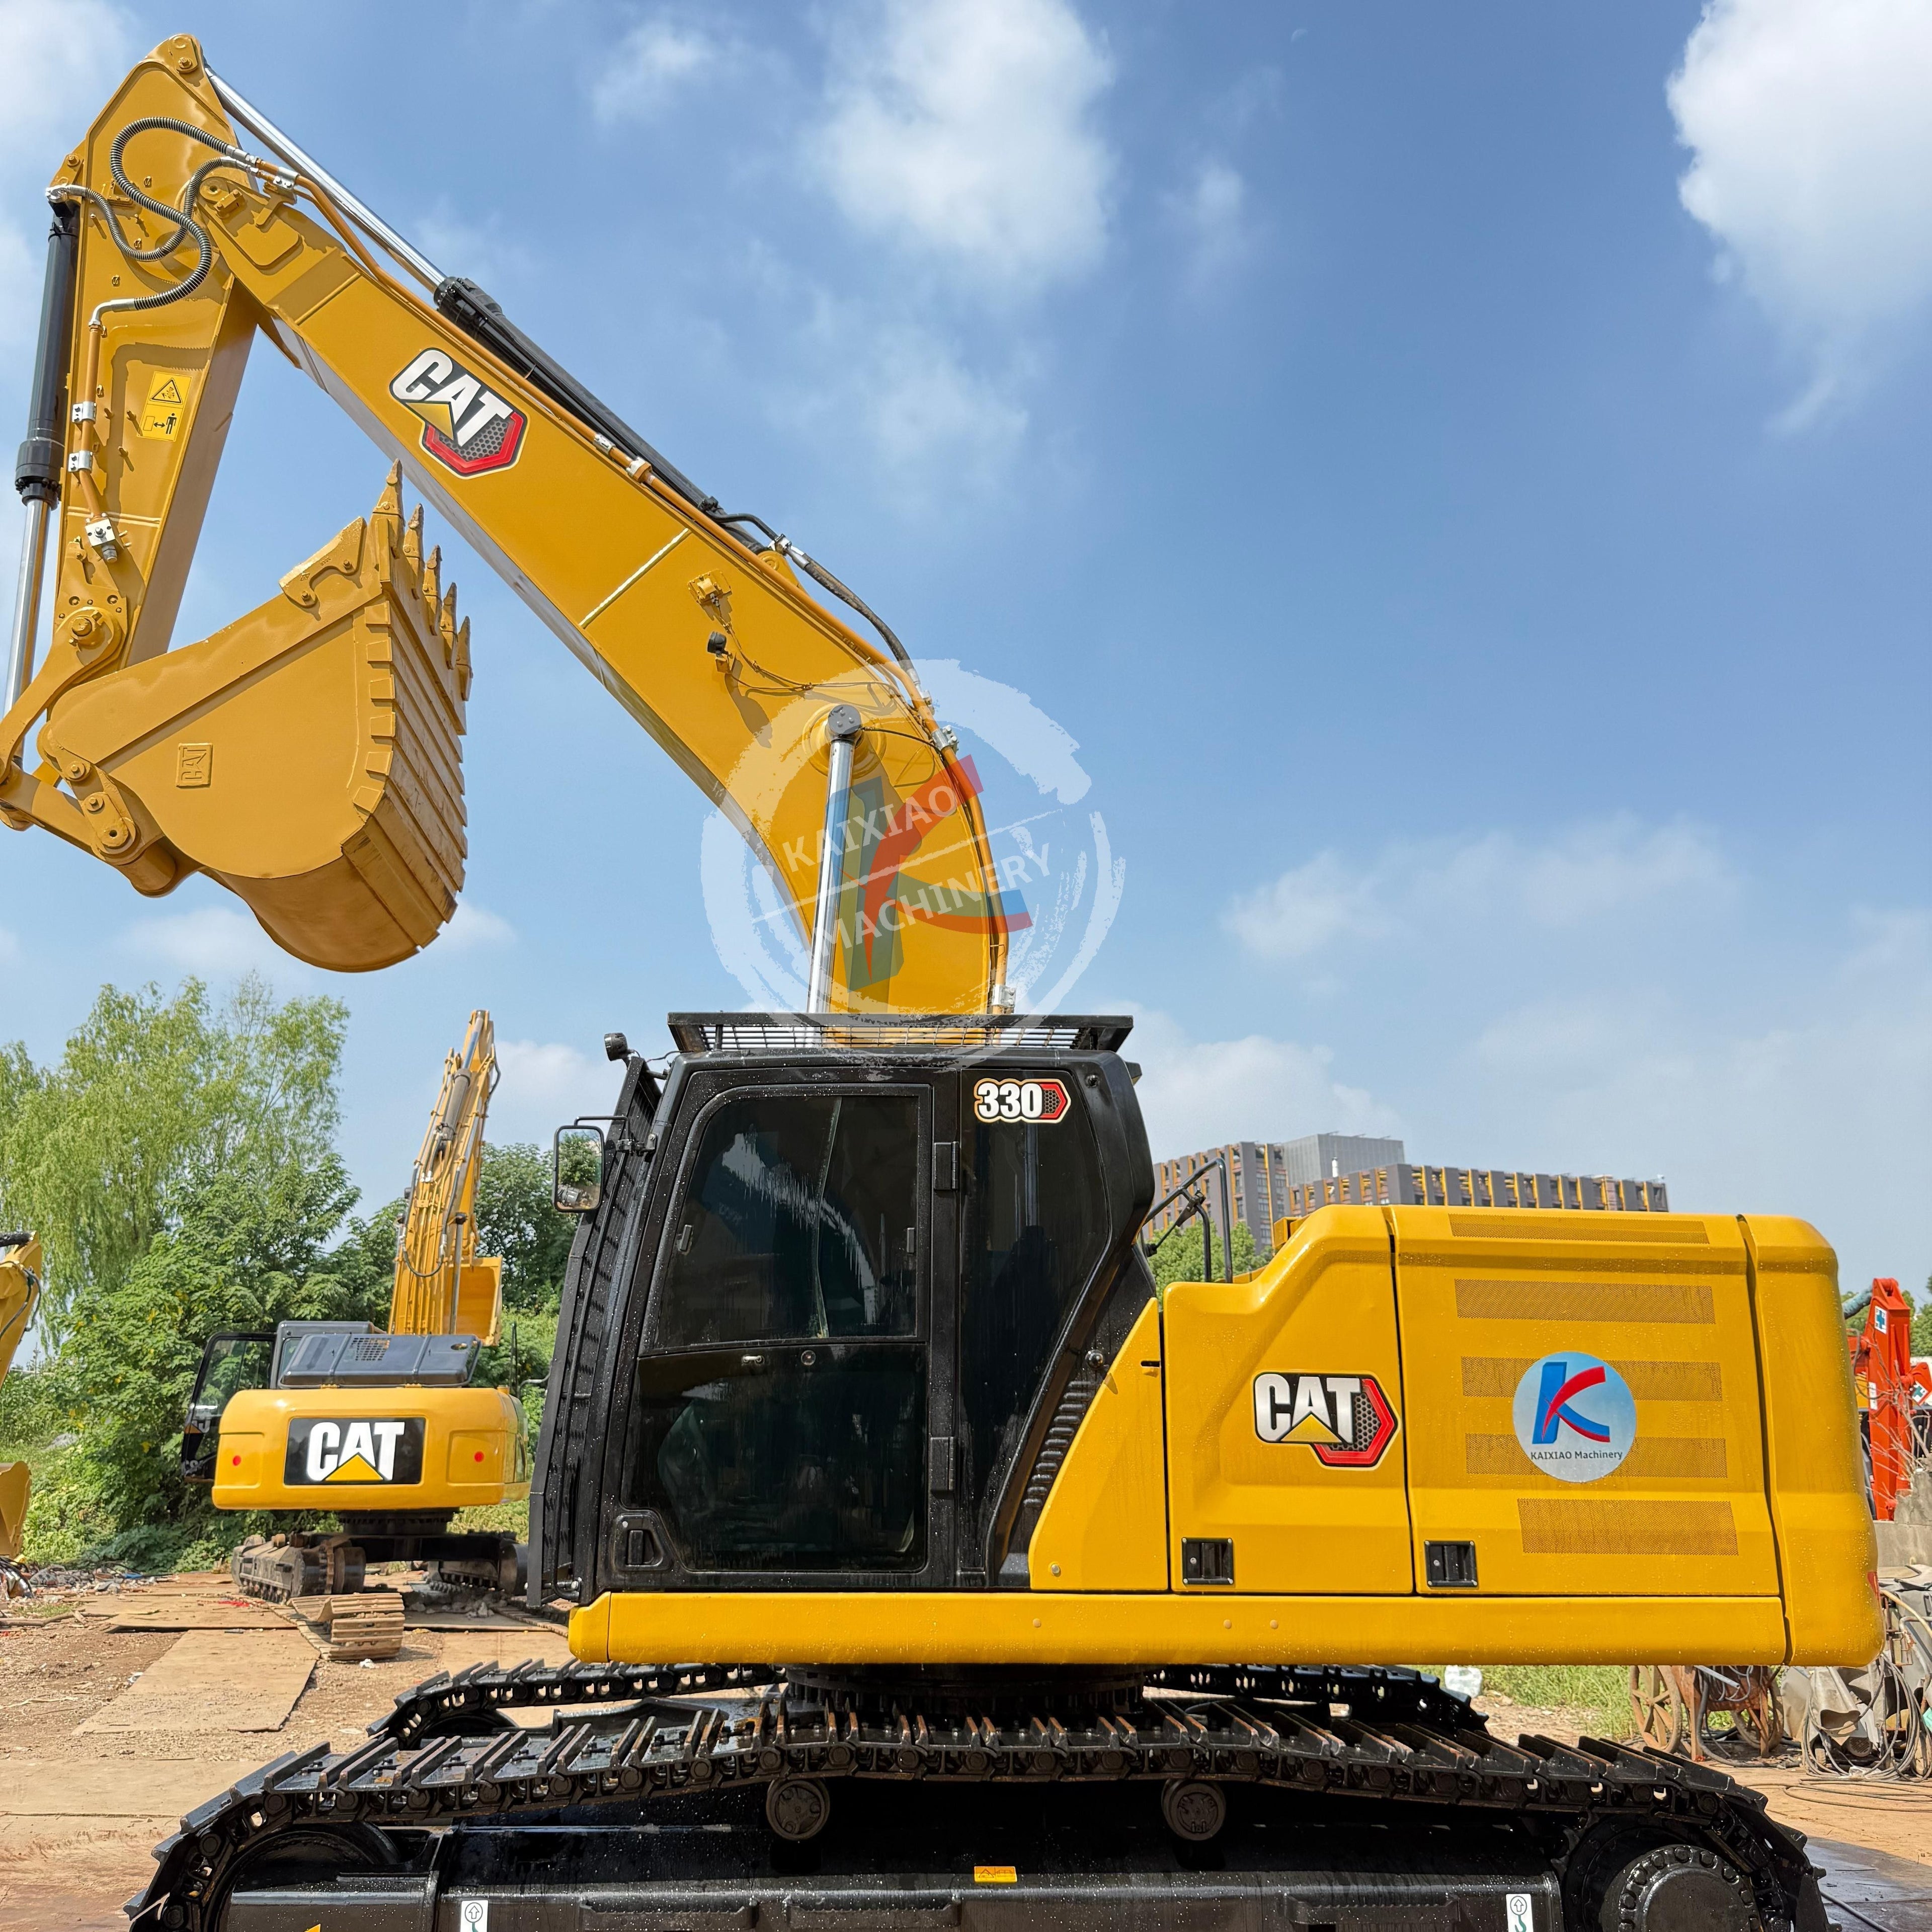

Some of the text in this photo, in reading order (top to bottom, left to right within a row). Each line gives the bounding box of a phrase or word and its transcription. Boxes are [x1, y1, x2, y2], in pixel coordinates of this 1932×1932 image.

[392, 349, 513, 447] CAT
[181, 747, 208, 783] CAT
[978, 1082, 1042, 1118] 330
[1255, 1373, 1361, 1444] CAT
[306, 1421, 405, 1482] CAT
[1531, 1450, 1623, 1460] KAIXIAO Machinery
